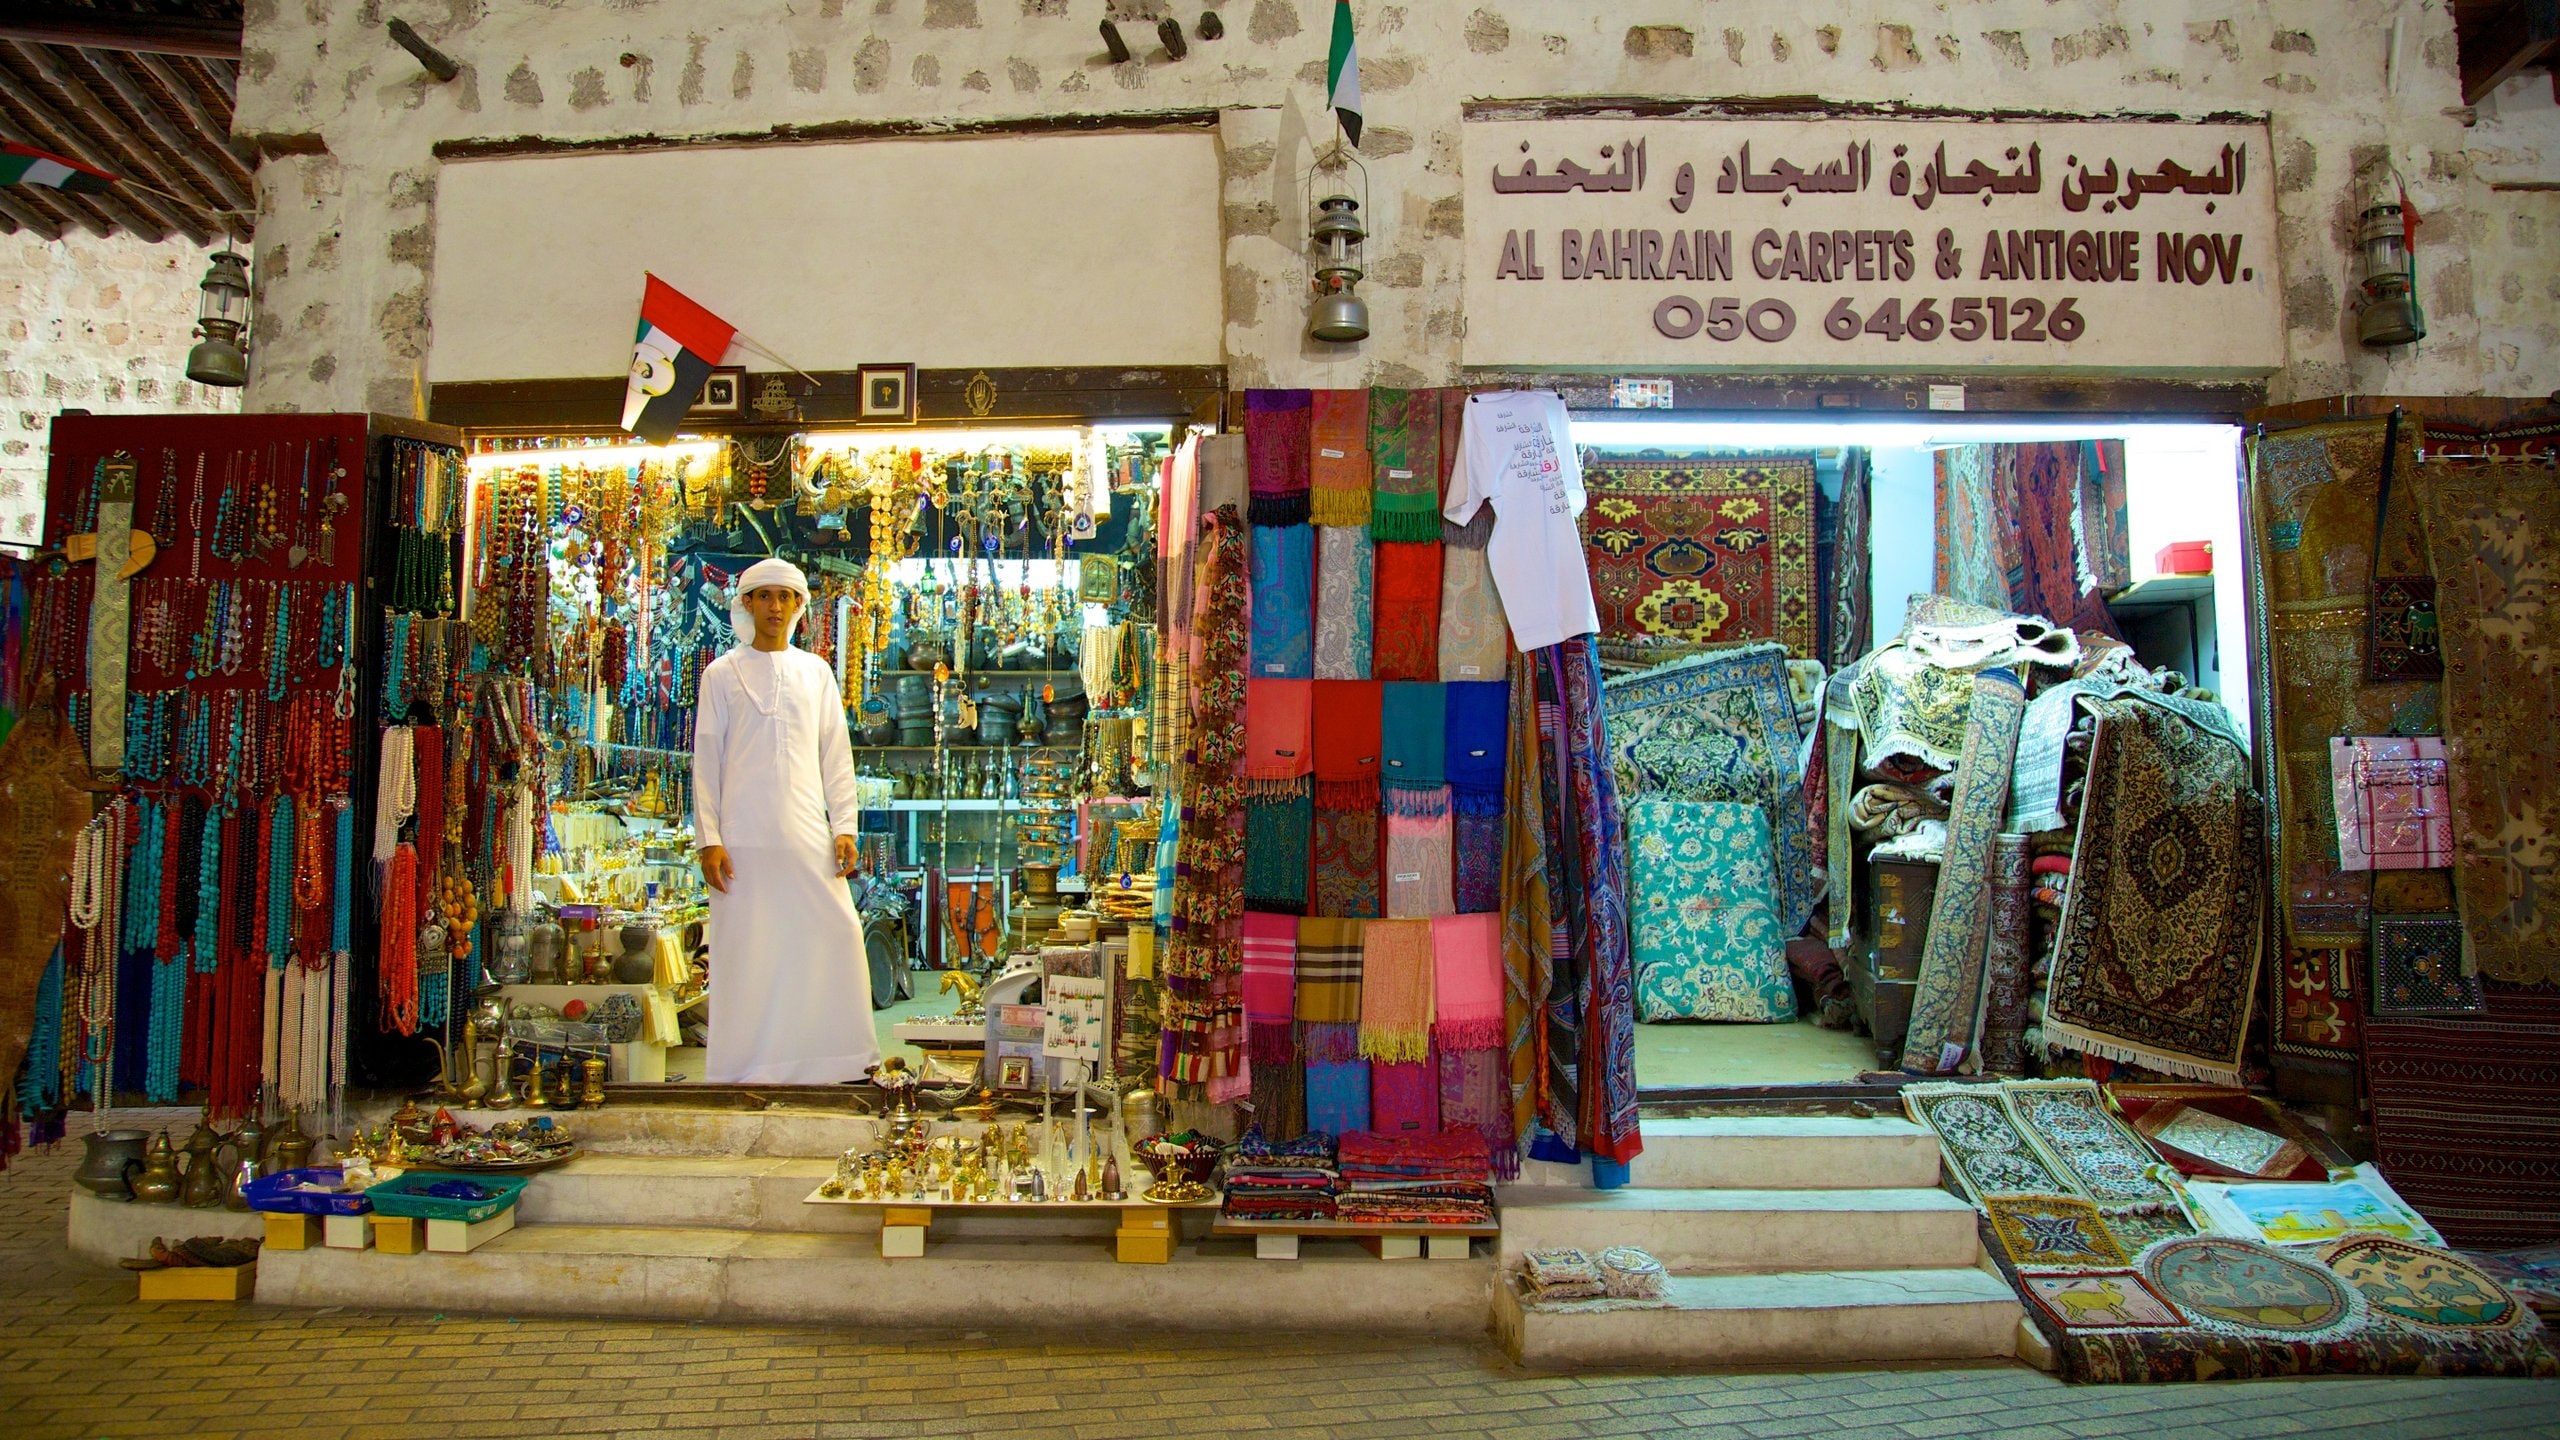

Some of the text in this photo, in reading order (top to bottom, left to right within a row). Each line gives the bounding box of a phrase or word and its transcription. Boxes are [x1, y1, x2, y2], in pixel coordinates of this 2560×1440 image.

[1493, 138, 2248, 216] البحرين لتجارة السجاد و التحف
[1497, 229, 2255, 287] AL BAHRAIN CARPETS & ANTIQUE NOV.
[1654, 296, 2087, 344] 050 6465126
[1904, 391, 1918, 410] 5
